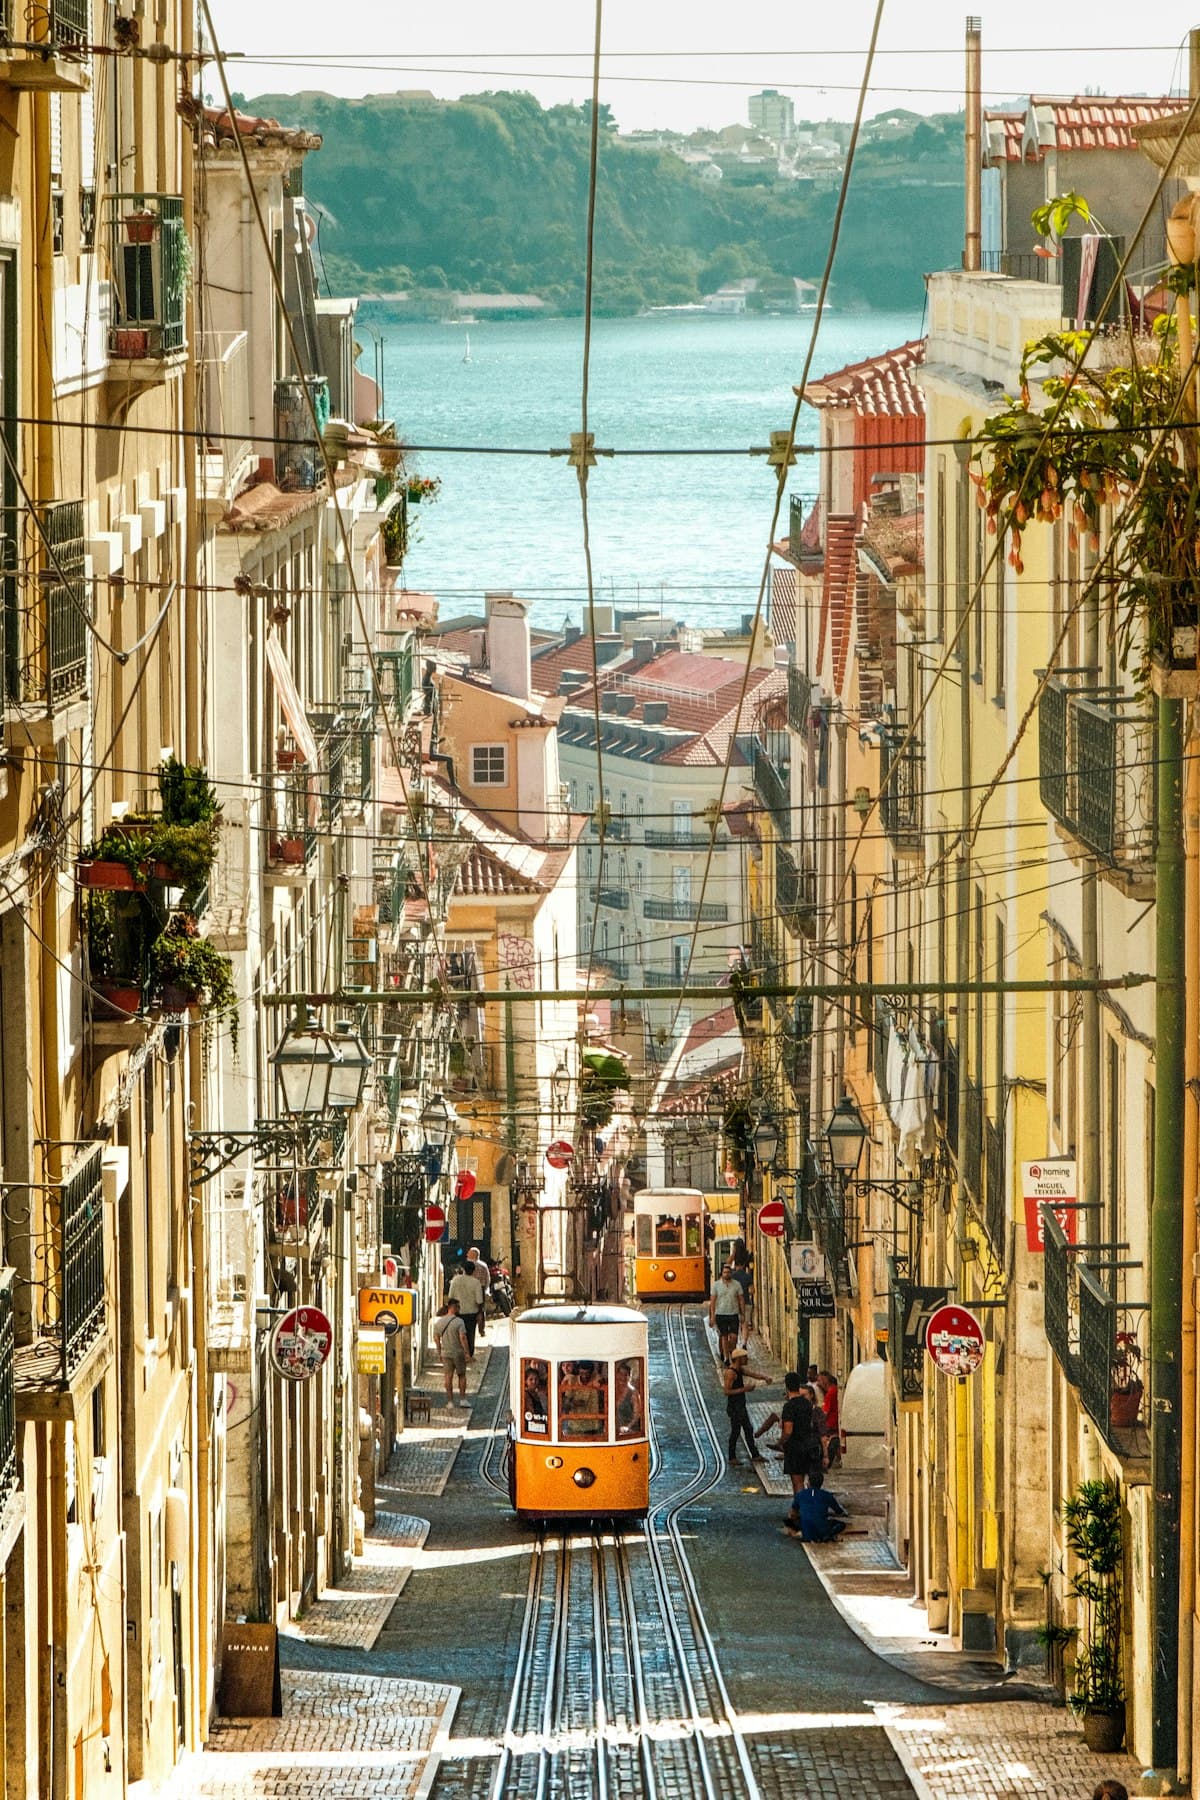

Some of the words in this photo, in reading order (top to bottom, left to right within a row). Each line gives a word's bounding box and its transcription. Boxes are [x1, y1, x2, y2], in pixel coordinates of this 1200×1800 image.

[1043, 1168, 1070, 1177] homing
[802, 1287, 819, 1297] BICA
[368, 1292, 404, 1305] ATM
[802, 1298, 821, 1308] SOUR
